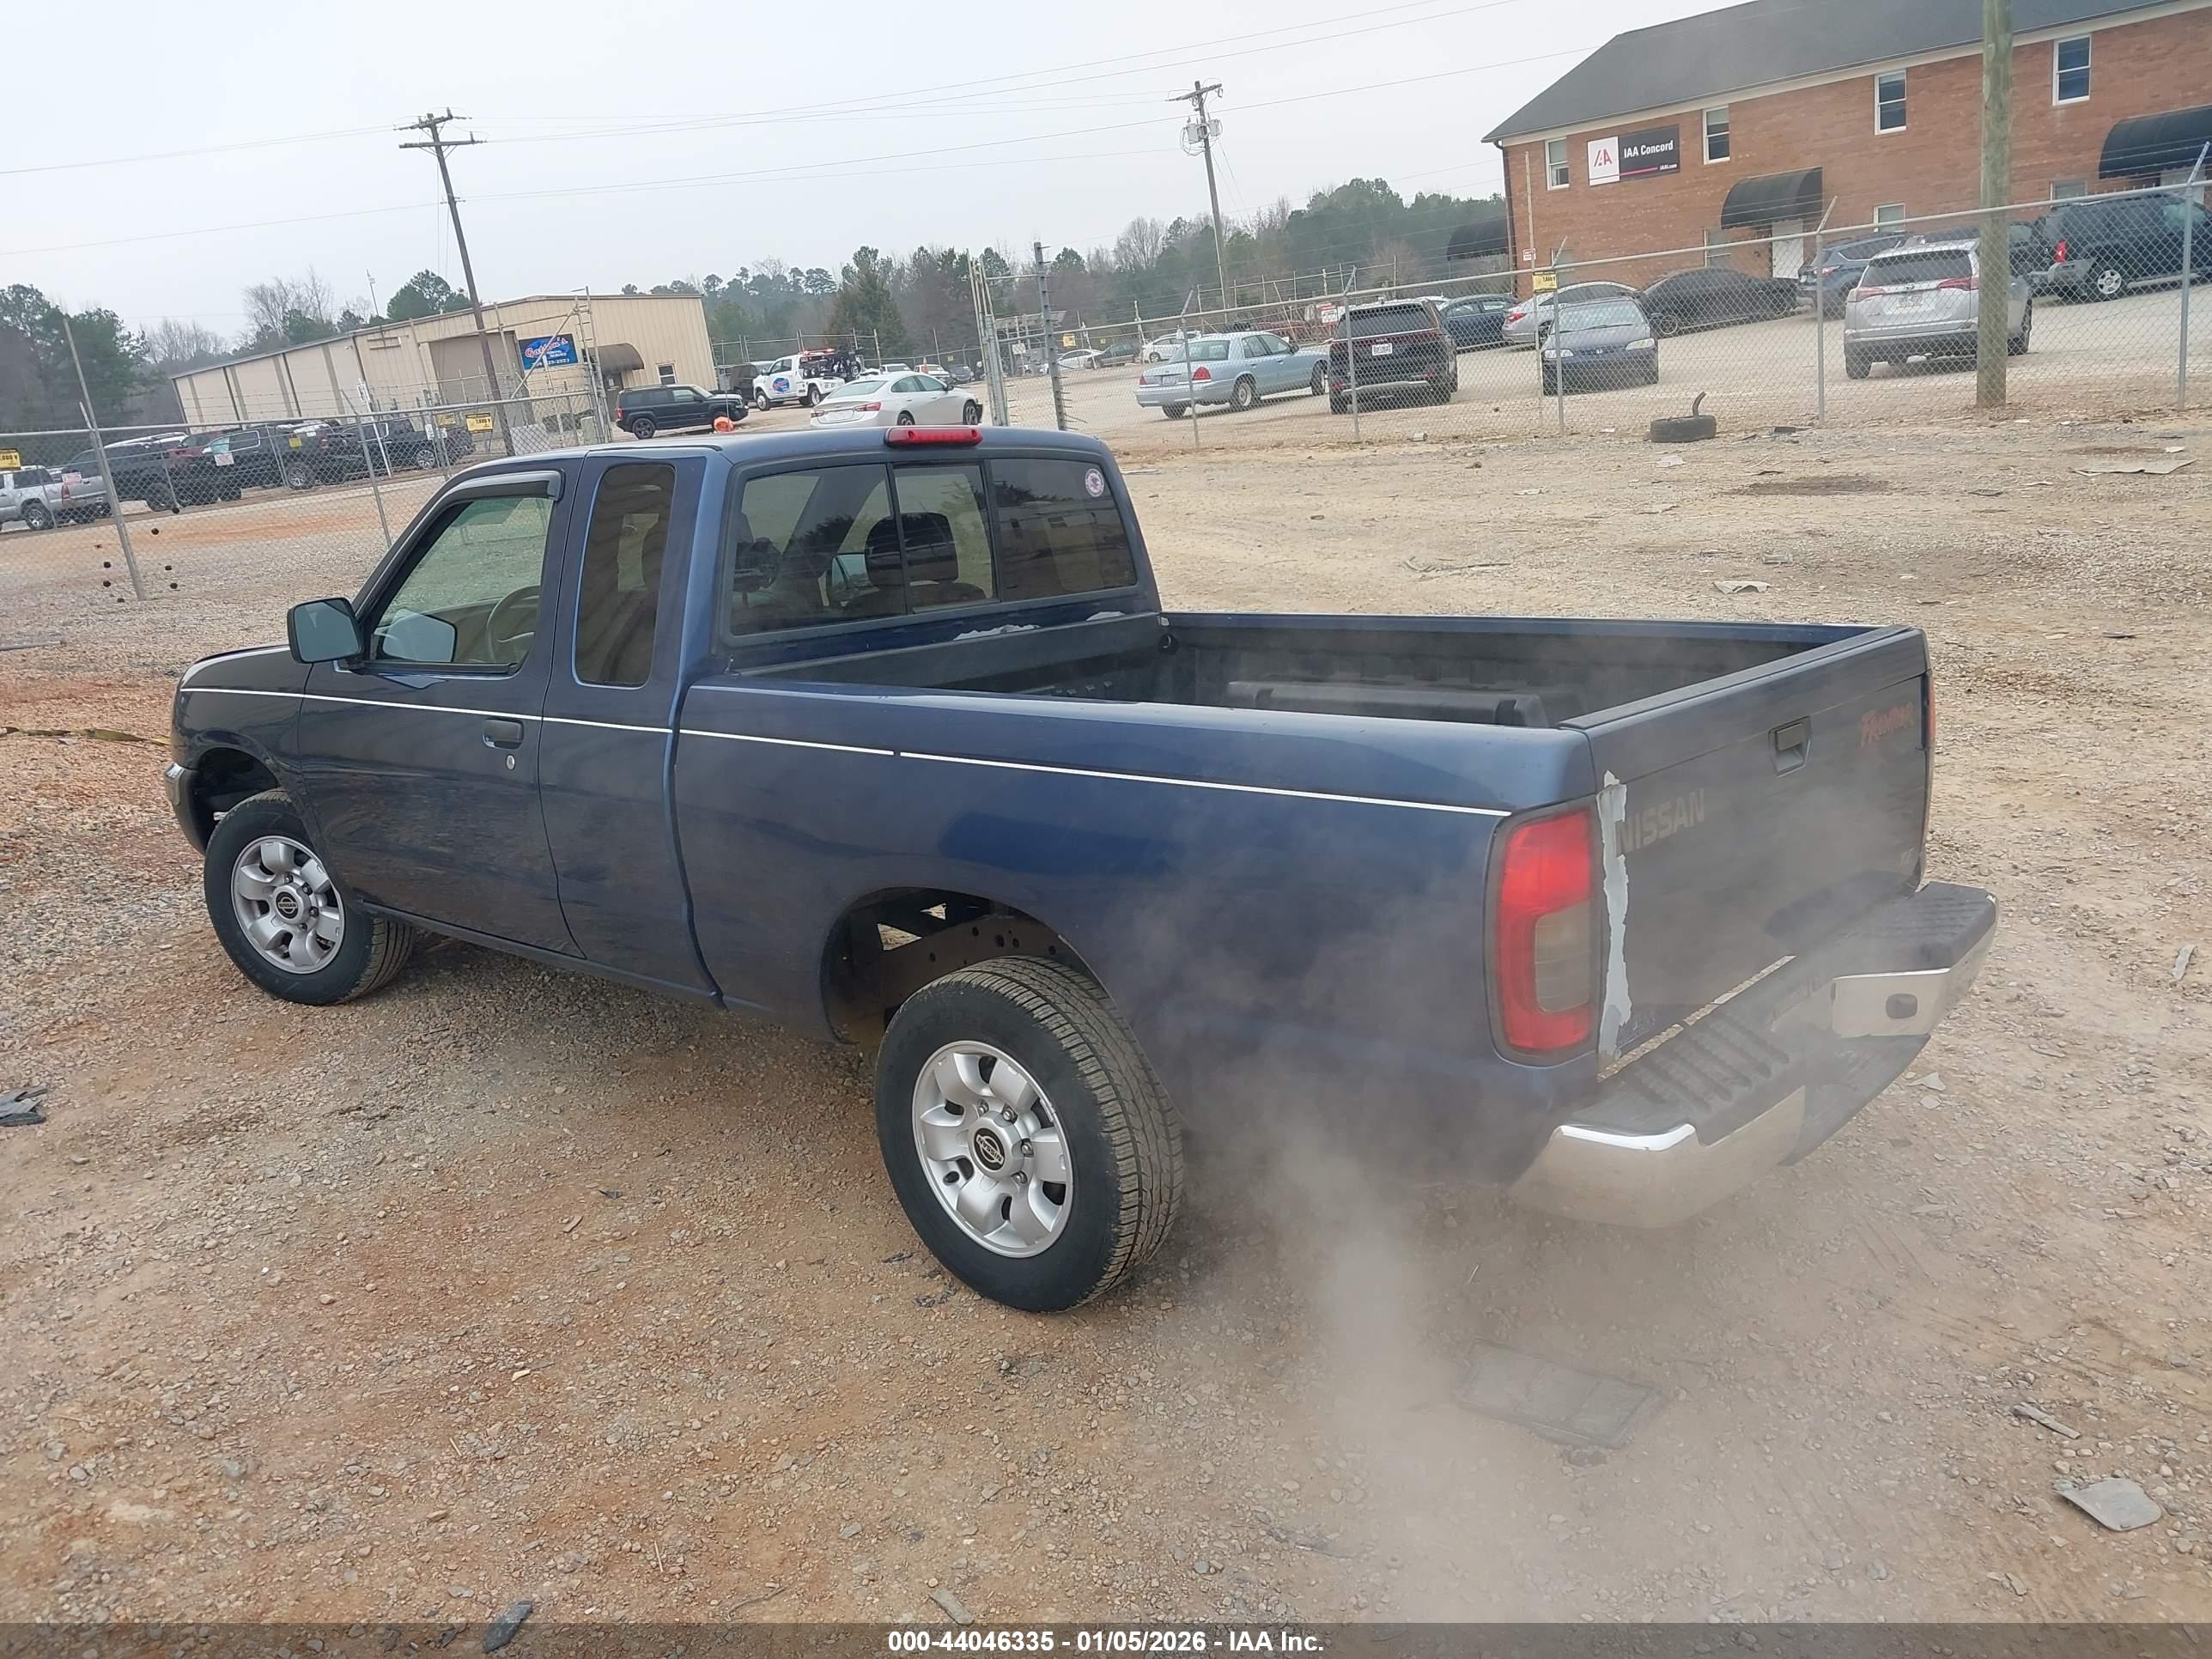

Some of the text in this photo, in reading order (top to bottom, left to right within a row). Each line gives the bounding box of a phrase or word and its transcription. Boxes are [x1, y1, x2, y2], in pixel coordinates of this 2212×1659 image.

[1624, 140, 1674, 159] IAA Concord
[1615, 788, 1705, 854] NISSAN
